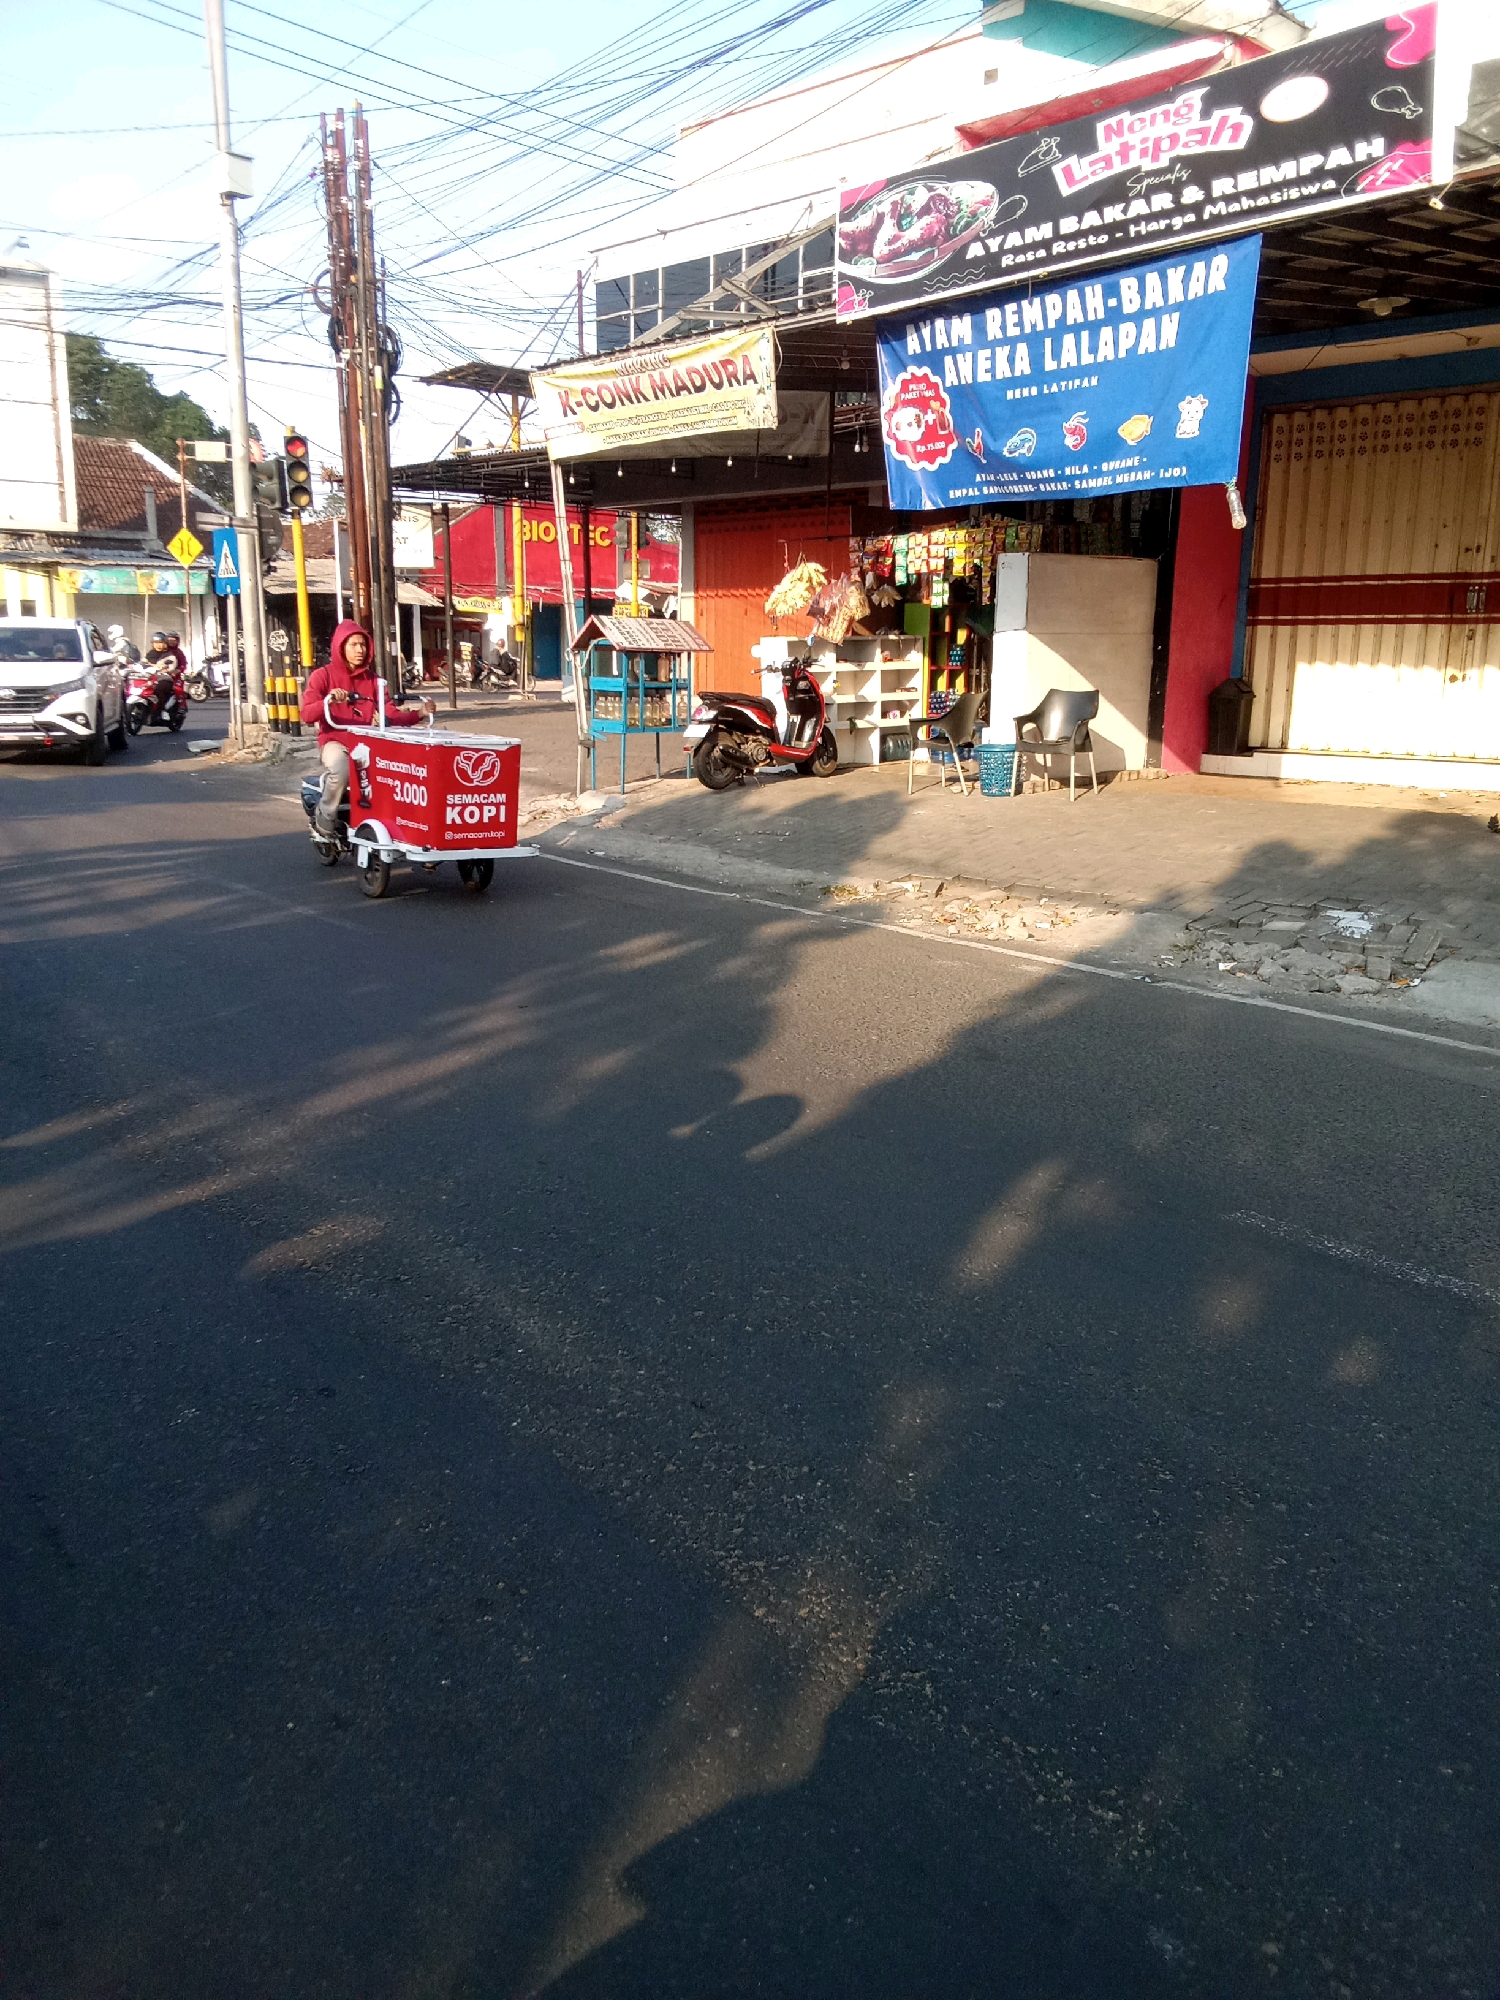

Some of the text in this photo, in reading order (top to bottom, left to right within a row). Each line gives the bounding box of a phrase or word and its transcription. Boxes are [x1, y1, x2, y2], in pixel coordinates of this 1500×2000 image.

[1060, 114, 1246, 188] Latipah
[965, 136, 1385, 260] AYAM BAKAR & REMPAH
[1001, 248, 1047, 268] Rasa
[1052, 234, 1109, 256] Resto
[1128, 212, 1196, 238] Harga
[1202, 178, 1337, 220] Mahasiswa
[905, 253, 1229, 355] AYAM REMPAH-BAKAR
[943, 311, 1181, 387] ANEKA LALAPAN
[556, 375, 651, 418] K-CONK
[649, 354, 760, 401] MADURA
[1065, 464, 1089, 476] NILA
[393, 780, 428, 807] 3.000
[411, 763, 428, 780] Kopi
[446, 793, 507, 804] SEMACAM
[446, 805, 506, 825] KOPI
